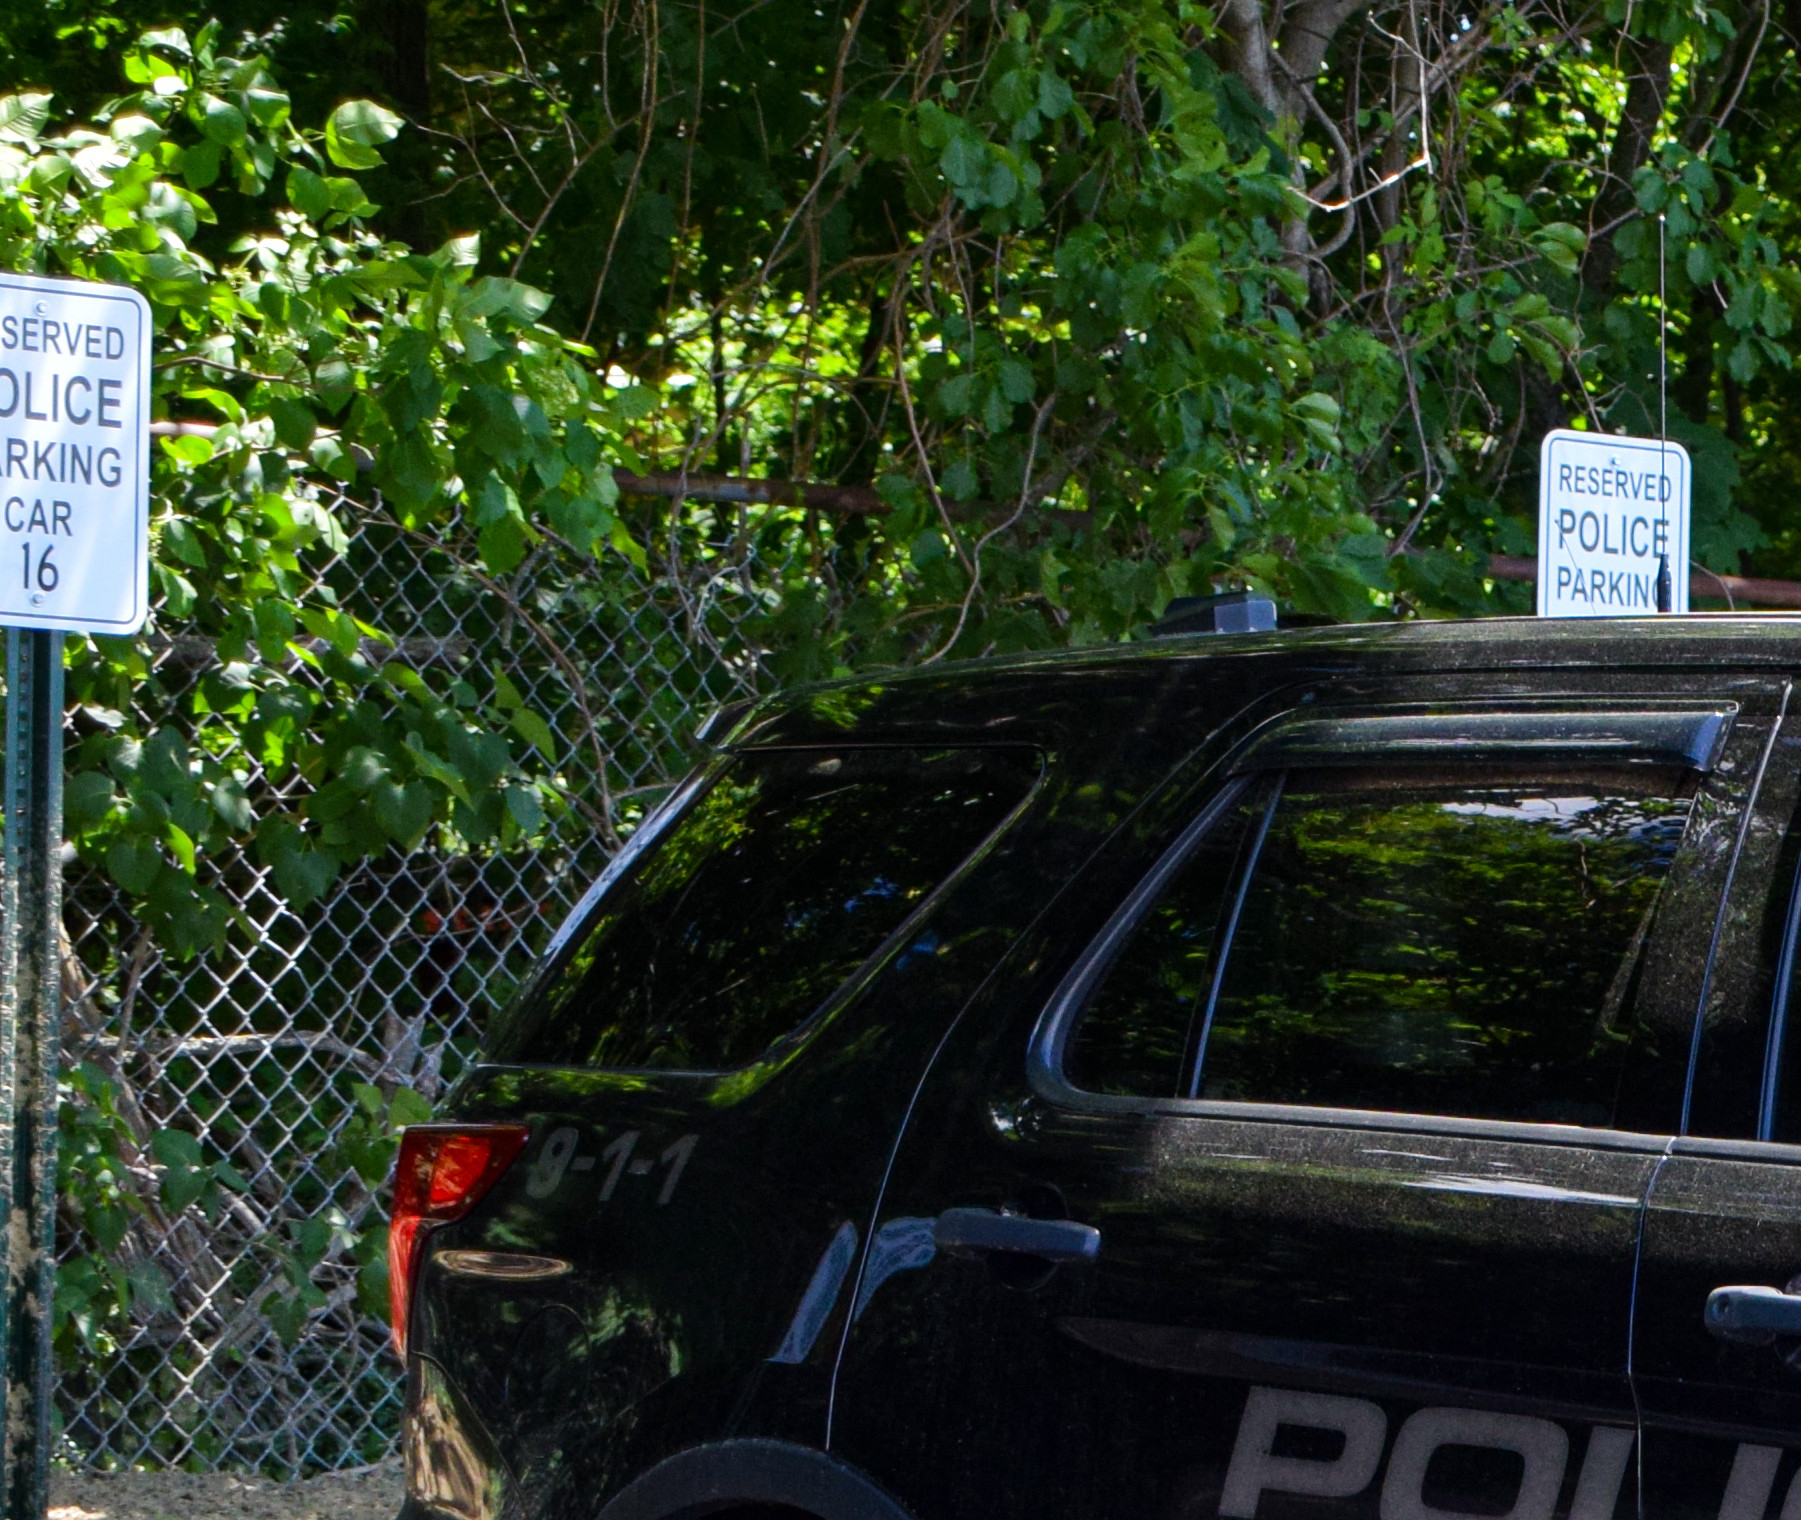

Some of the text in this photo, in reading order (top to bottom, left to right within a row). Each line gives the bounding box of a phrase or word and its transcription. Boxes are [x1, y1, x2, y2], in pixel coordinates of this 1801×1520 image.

[1, 315, 125, 361] SERVED
[0, 367, 122, 428] OLICE
[0, 437, 122, 488] RKING
[1559, 463, 1672, 503] RESERVED
[4, 496, 73, 537] CAR
[1558, 508, 1670, 558] POLICE
[21, 542, 59, 592] 16
[1557, 566, 1666, 609] PARKIN
[525, 1127, 700, 1205] 9-1-1
